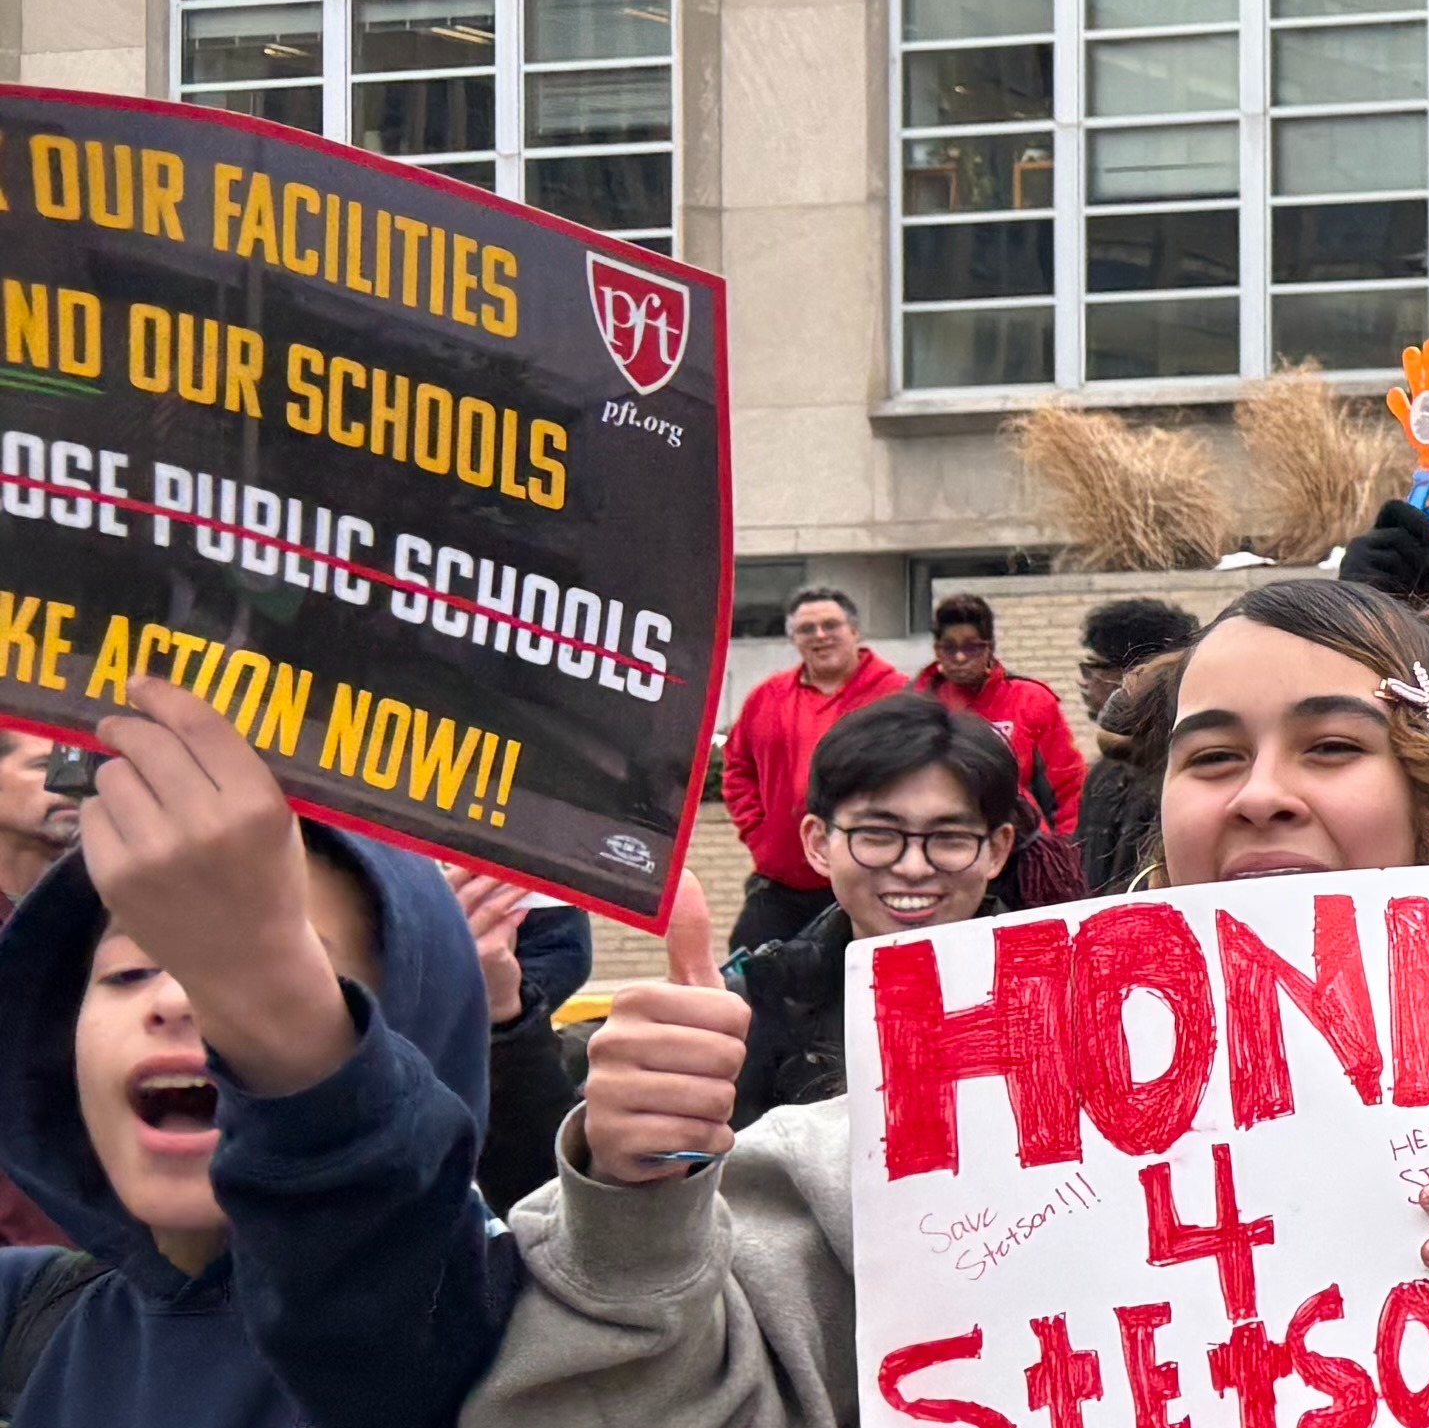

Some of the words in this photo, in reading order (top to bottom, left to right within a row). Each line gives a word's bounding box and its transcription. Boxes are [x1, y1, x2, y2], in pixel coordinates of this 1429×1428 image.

[29, 133, 186, 243] OUR
[212, 163, 520, 339] FACILITIES
[602, 281, 681, 368] pft
[128, 302, 264, 419] OUR
[286, 342, 569, 512] SCHOOLS
[601, 398, 685, 448] pft.org
[0, 429, 129, 538] OSE
[152, 460, 375, 606] PUBLIC
[390, 532, 674, 704] SCHOOLS
[0, 590, 76, 691] KE
[84, 613, 314, 758] ACTION
[319, 680, 523, 829] NOW!!
[919, 1207, 998, 1254] Save
[1137, 1142, 1276, 1321] 4
